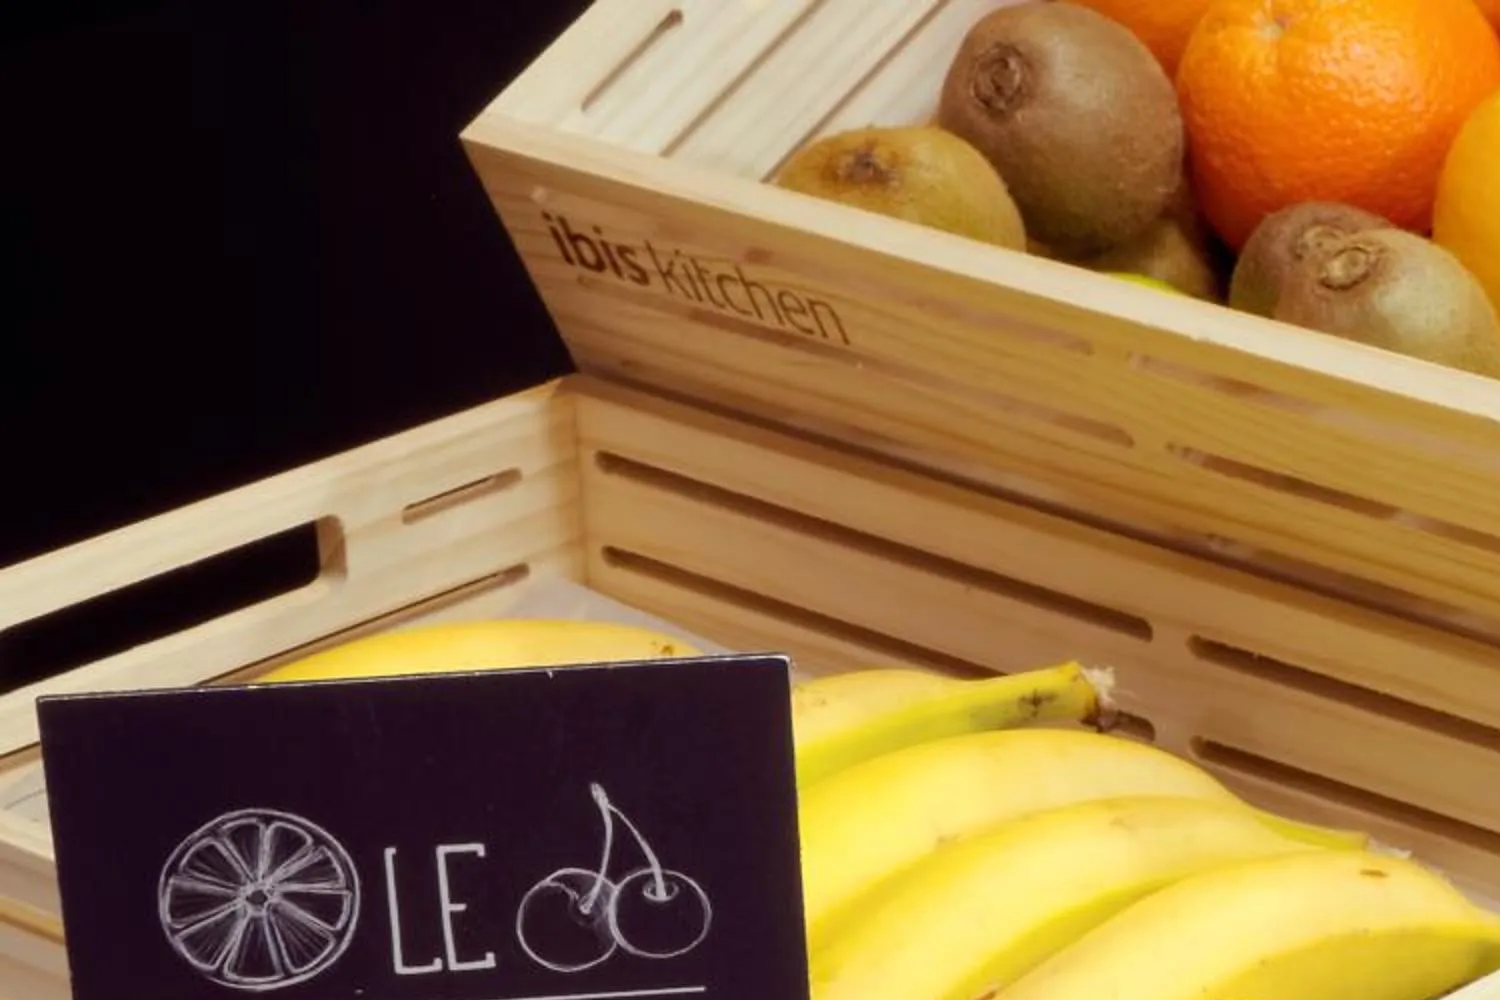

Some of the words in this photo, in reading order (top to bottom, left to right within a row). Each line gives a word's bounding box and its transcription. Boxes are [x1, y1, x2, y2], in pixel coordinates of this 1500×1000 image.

[542, 209, 650, 286] ibis
[645, 239, 850, 345] kitchen
[383, 843, 496, 976] LE
